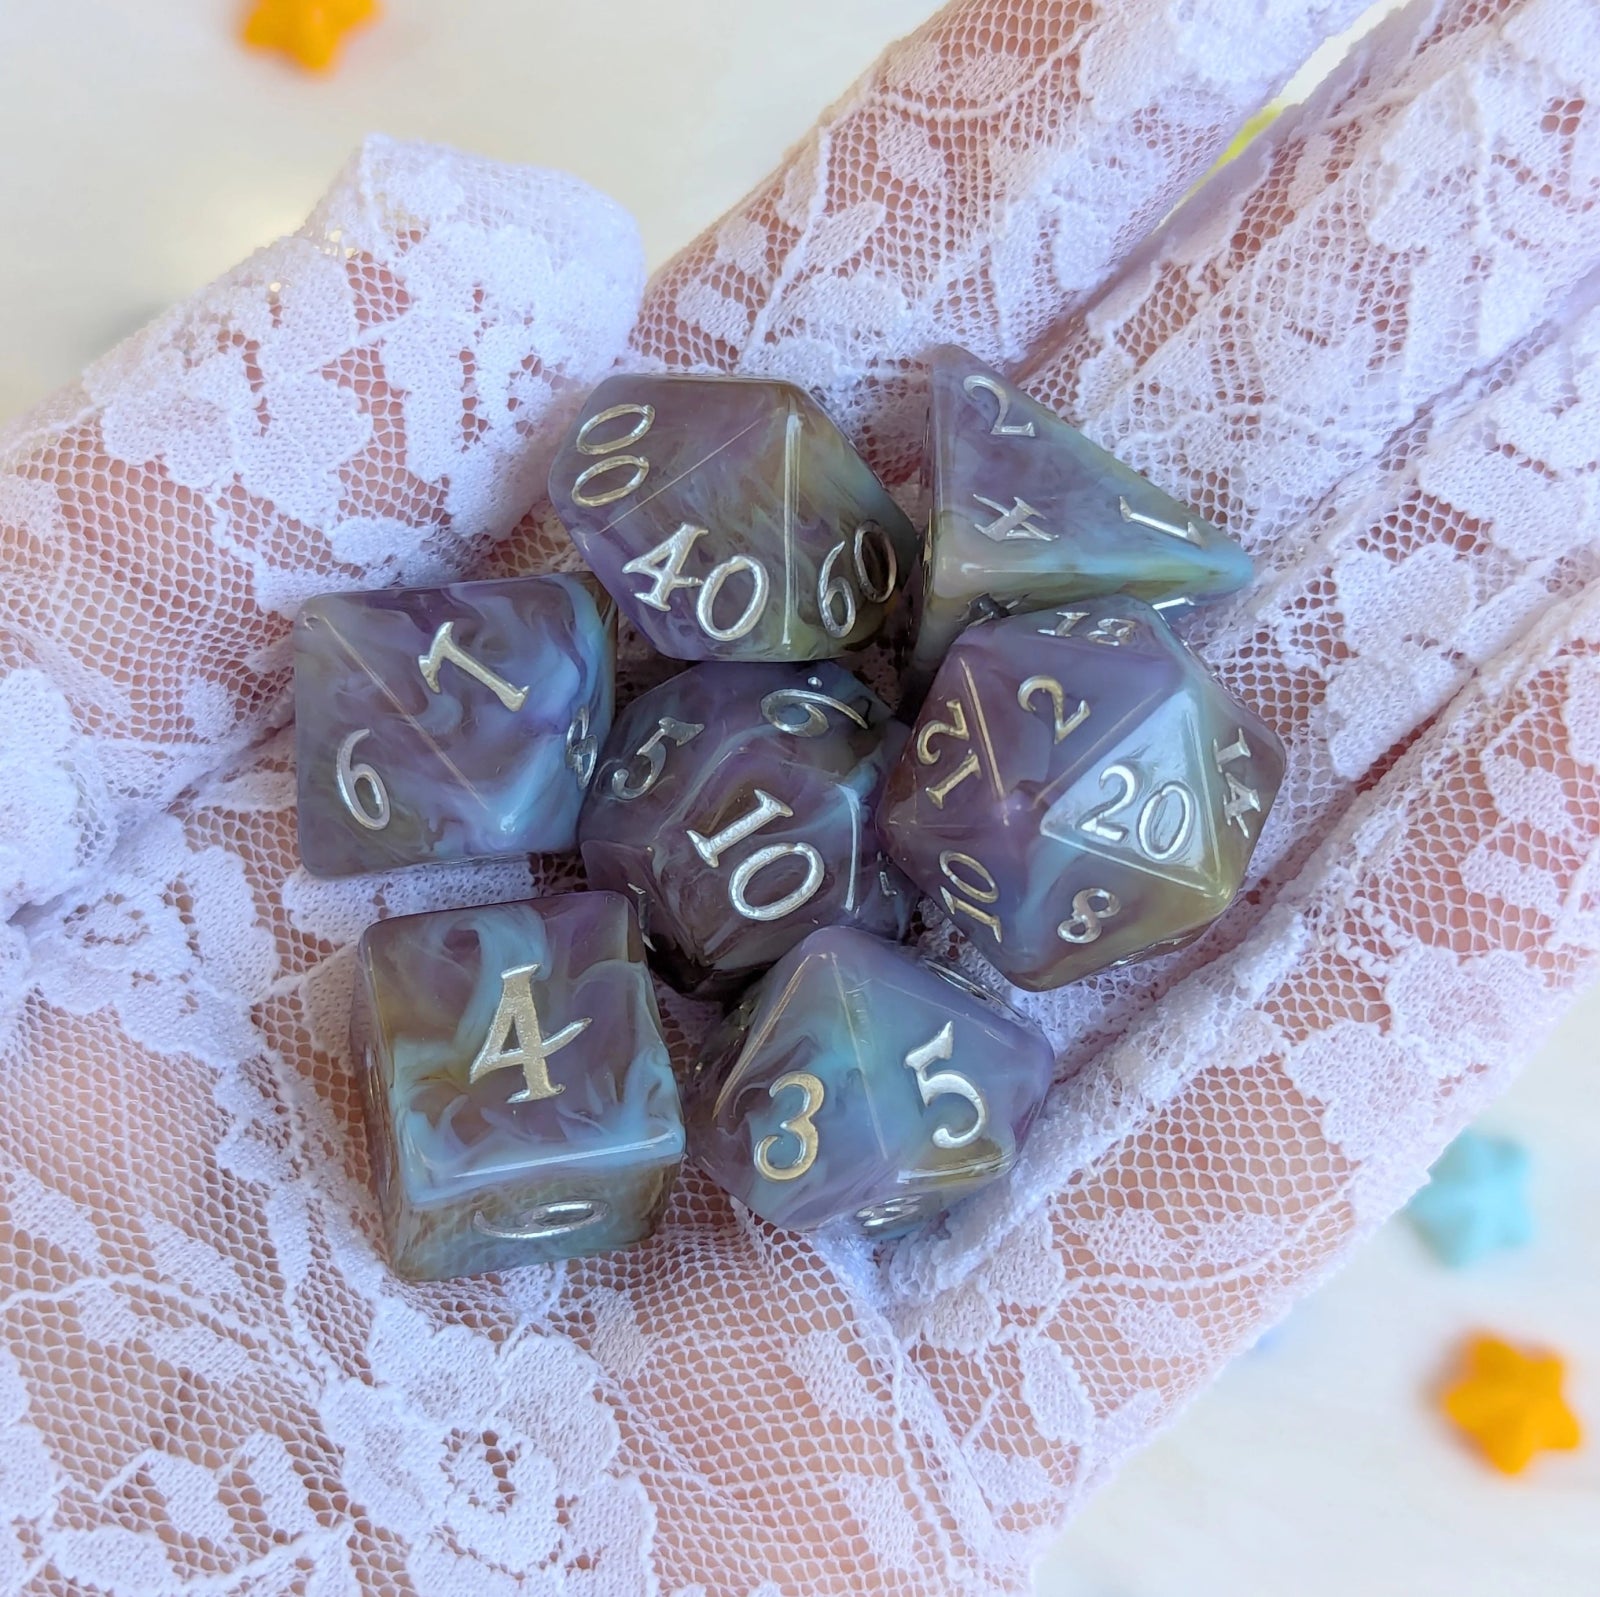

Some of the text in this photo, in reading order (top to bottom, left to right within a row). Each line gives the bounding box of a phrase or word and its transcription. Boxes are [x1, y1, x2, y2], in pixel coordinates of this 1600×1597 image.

[571, 403, 655, 506] 00
[963, 375, 1036, 437] 2
[973, 494, 1060, 542] 4
[1119, 496, 1204, 550] 1
[622, 522, 769, 641] 40
[818, 519, 898, 638] 60
[418, 621, 530, 712] 1
[1017, 675, 1091, 745] 2
[336, 728, 390, 830] 6
[611, 716, 705, 800] 5
[916, 700, 982, 810] 12
[1212, 728, 1261, 838] 14
[686, 788, 825, 921] 10
[1079, 764, 1196, 860] 20
[939, 850, 1001, 943] 10
[1057, 887, 1121, 944] 8
[469, 963, 593, 1103] 4
[754, 1071, 825, 1181] 3
[905, 1020, 987, 1149] 5
